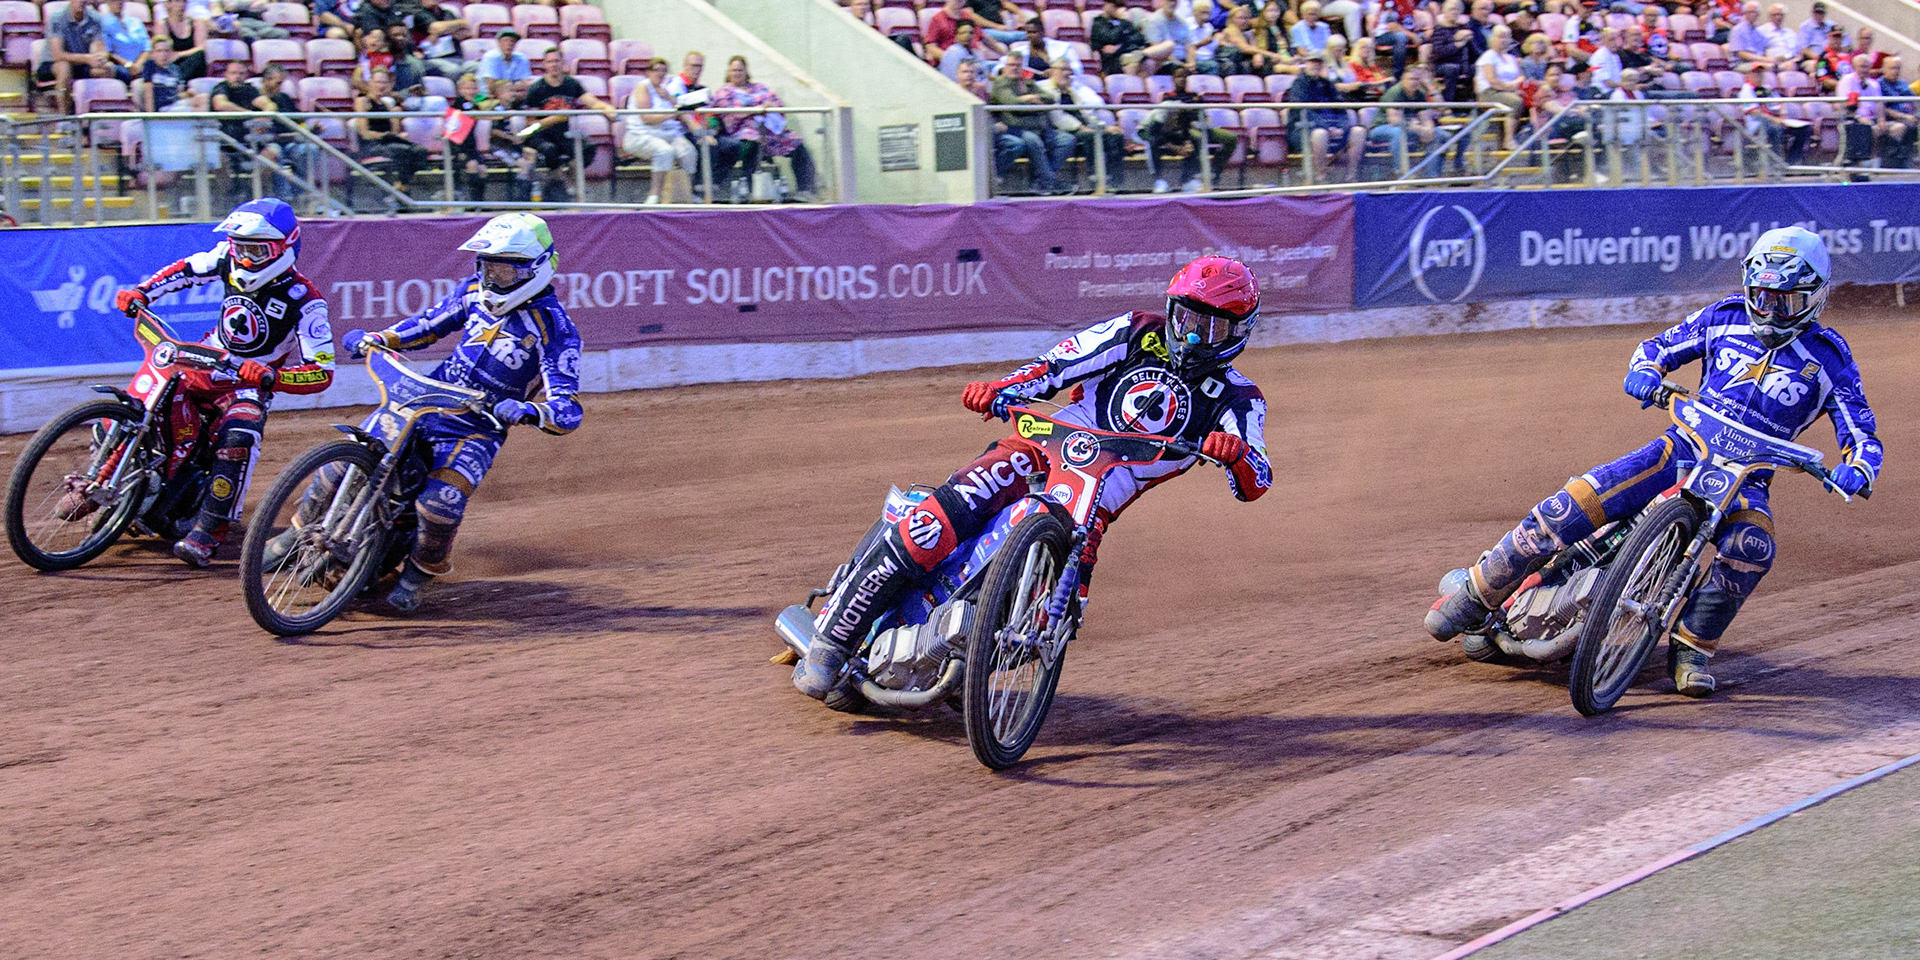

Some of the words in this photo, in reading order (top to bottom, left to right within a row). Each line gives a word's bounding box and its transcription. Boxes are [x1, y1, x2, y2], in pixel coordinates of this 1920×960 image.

[1422, 237, 1473, 268] ATPI
[1519, 227, 1681, 272] Delivering
[1690, 221, 1779, 260] Worl
[1045, 250, 1092, 270] Proud
[1094, 253, 1111, 268] to
[1114, 252, 1172, 271] sponsor
[686, 261, 988, 305] SOLICITORS.CO.UK
[1800, 361, 1820, 379] 2
[1131, 372, 1163, 384] BELLE
[1176, 394, 1187, 420] ACES
[1021, 419, 1051, 433] Rentruck
[1720, 425, 1758, 448] Minors
[1710, 433, 1723, 447] &
[953, 450, 1033, 511] Nice
[1703, 477, 1725, 489] ATPI
[1053, 490, 1069, 499] ATPI
[1744, 535, 1769, 553] ATPI
[830, 555, 899, 642] INOTHERM
